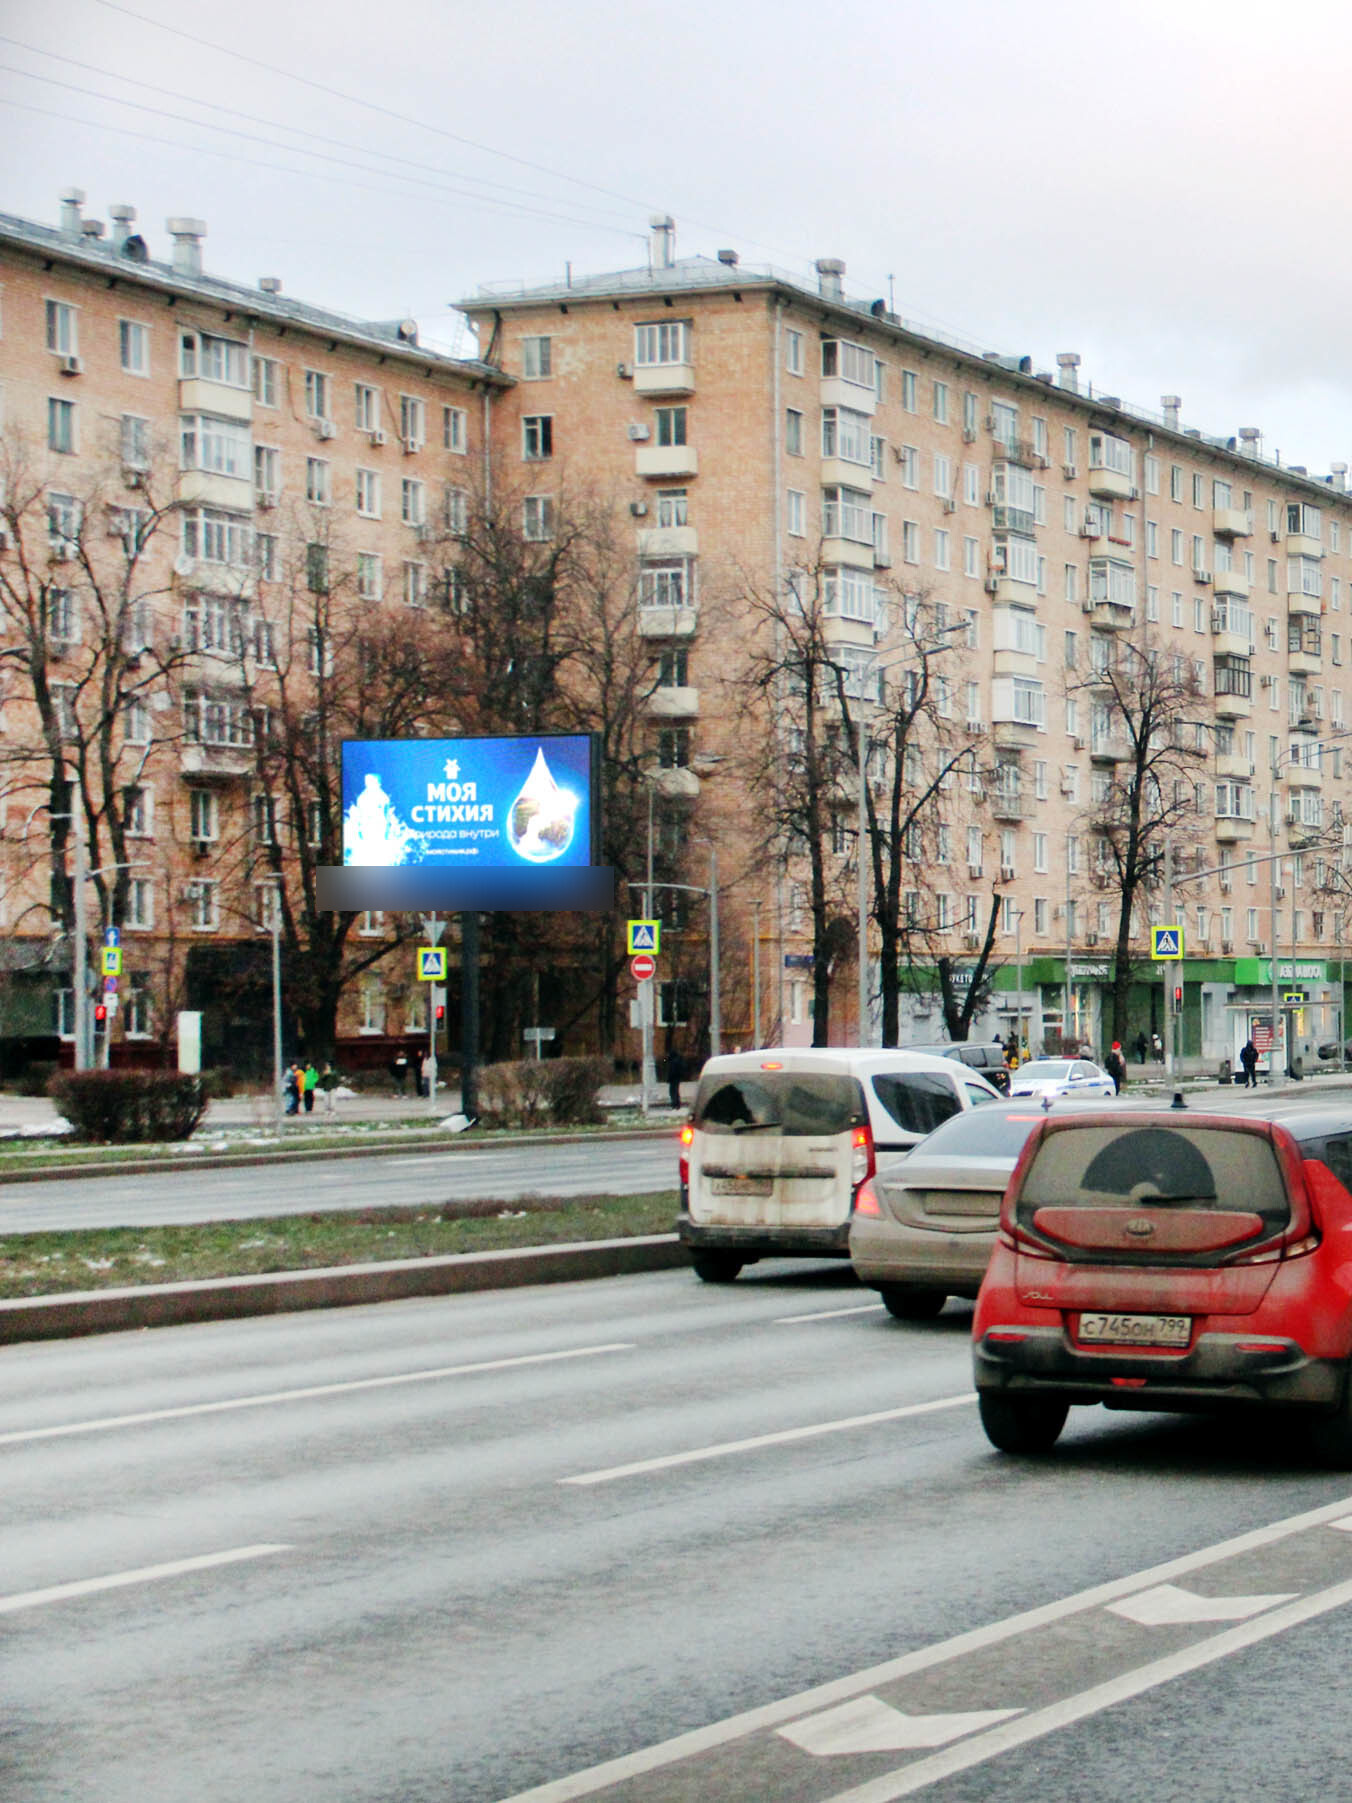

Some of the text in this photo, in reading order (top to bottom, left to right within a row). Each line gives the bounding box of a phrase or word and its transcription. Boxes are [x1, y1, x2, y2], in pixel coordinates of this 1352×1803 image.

[427, 781, 477, 802] МОЯ
[411, 804, 494, 823] СТИХИЯ
[459, 827, 500, 840] внутри
[1159, 1318, 1185, 1334] 799
